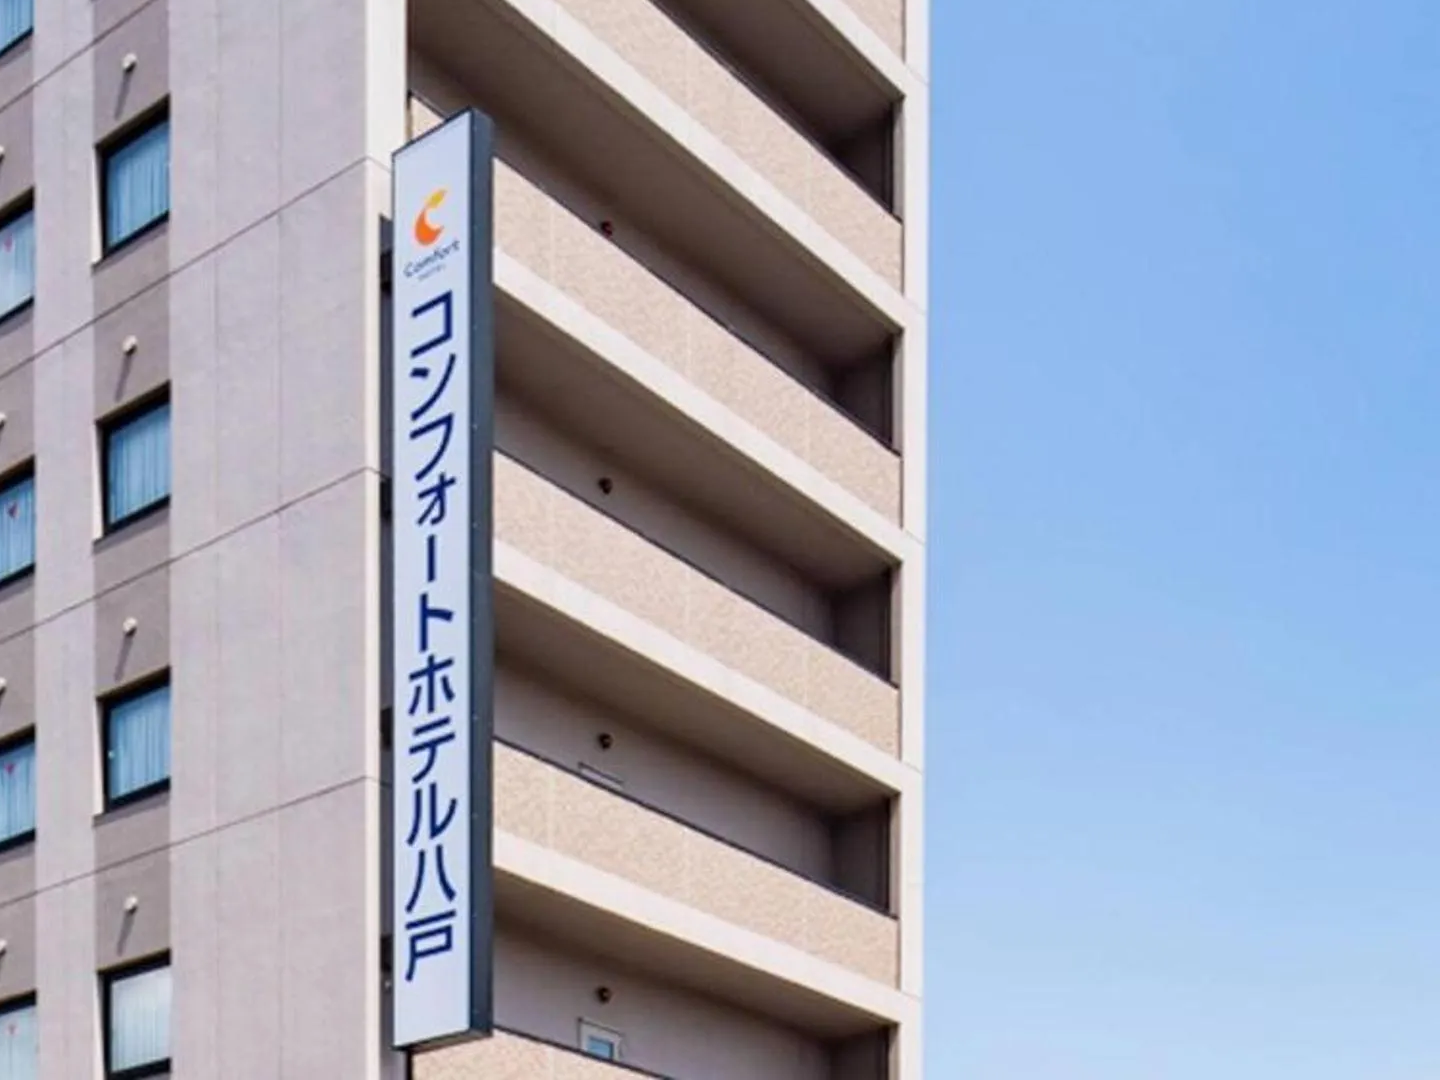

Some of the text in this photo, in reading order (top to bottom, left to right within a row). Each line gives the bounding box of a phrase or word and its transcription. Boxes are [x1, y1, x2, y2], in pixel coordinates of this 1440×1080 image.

[403, 240, 460, 278] Comfort
[405, 289, 457, 982] コンフォートホテル八戸
